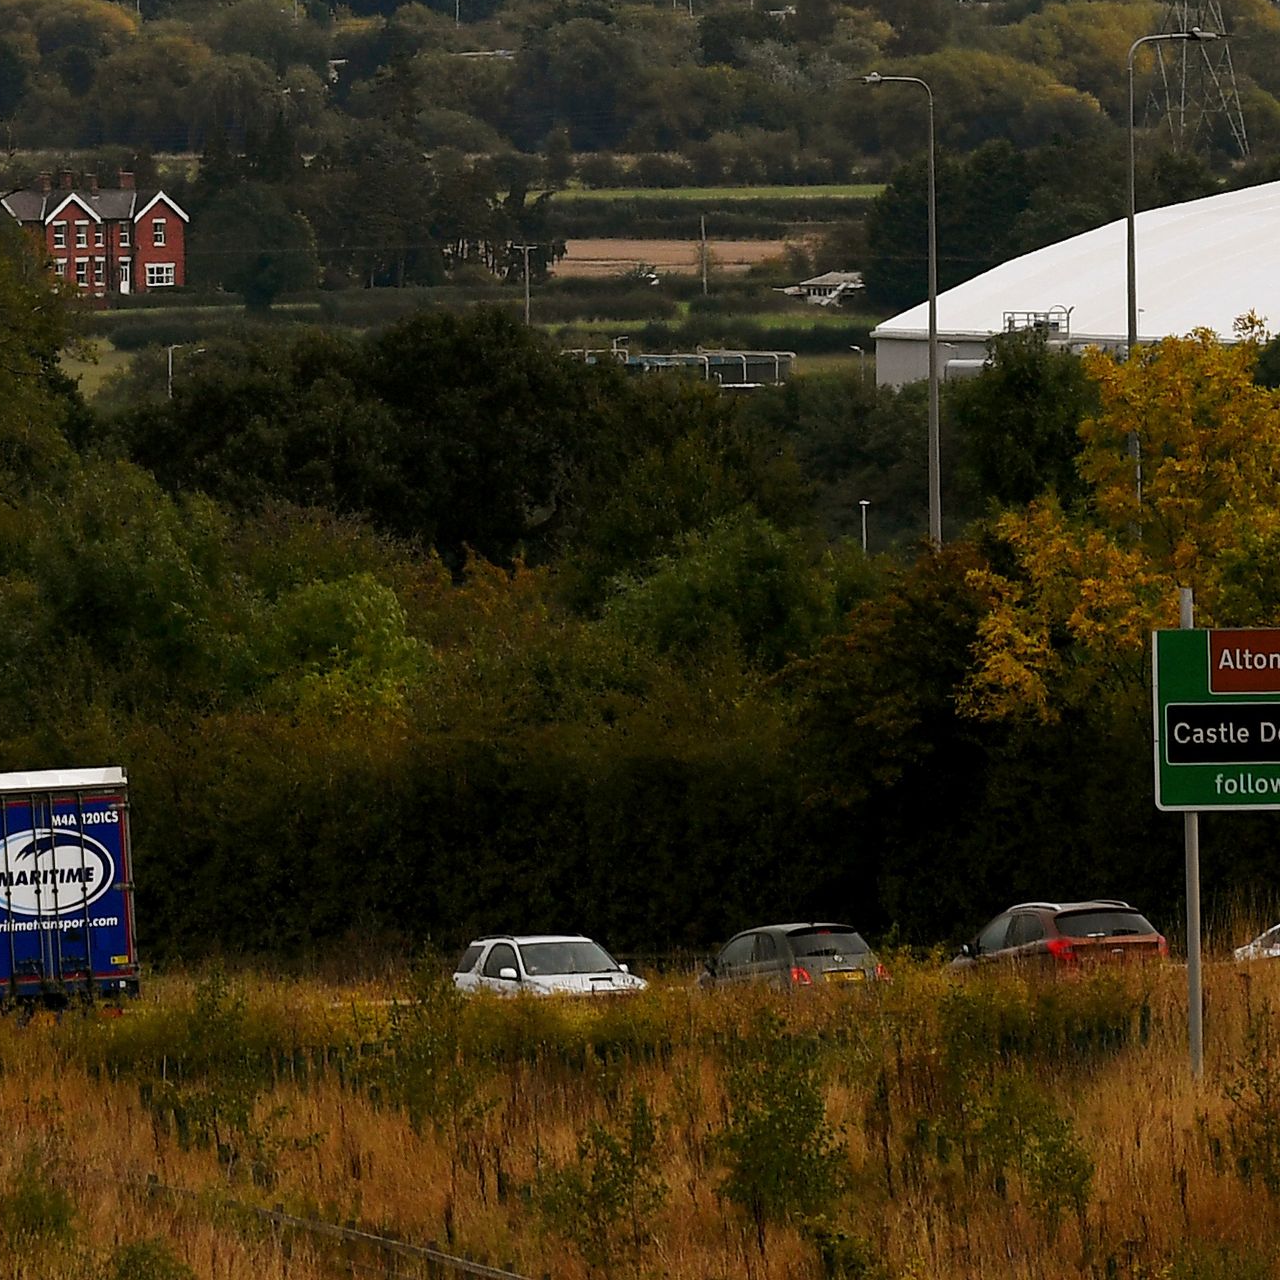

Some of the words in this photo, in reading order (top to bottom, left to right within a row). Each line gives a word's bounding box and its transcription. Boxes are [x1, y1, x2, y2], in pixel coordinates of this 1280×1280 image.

[1218, 648, 1280, 670] Alton
[1174, 722, 1250, 744] Castle
[1260, 722, 1280, 743] D
